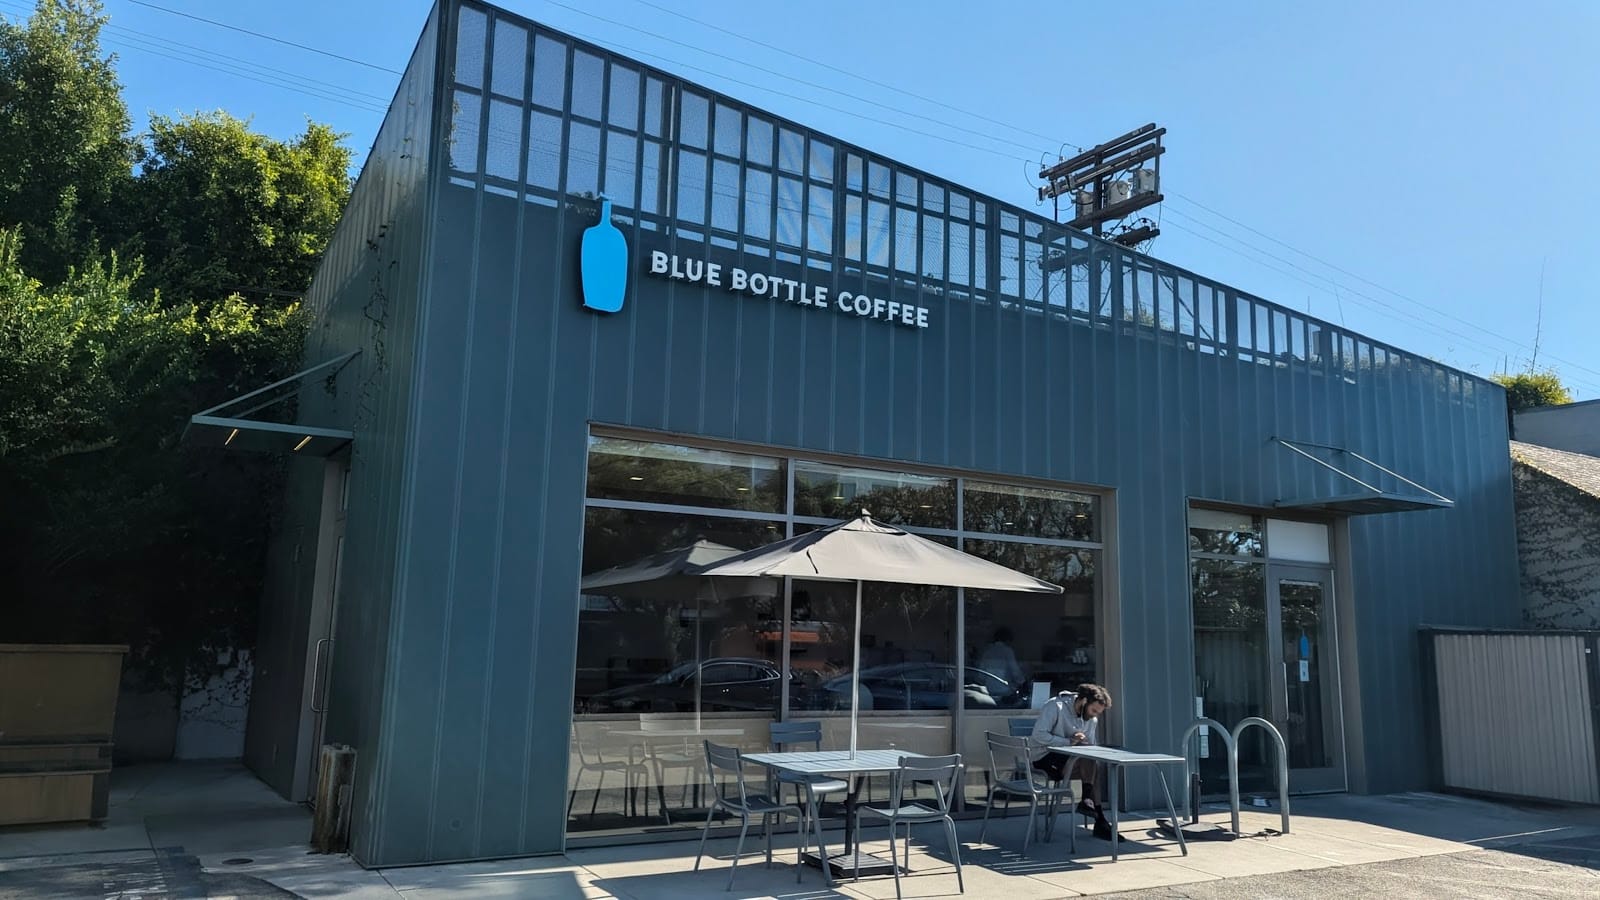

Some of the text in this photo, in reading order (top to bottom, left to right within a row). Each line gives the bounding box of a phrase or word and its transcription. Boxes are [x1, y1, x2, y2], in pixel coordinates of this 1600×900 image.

[652, 250, 929, 328] BLUE BOTTLE COFFEE
